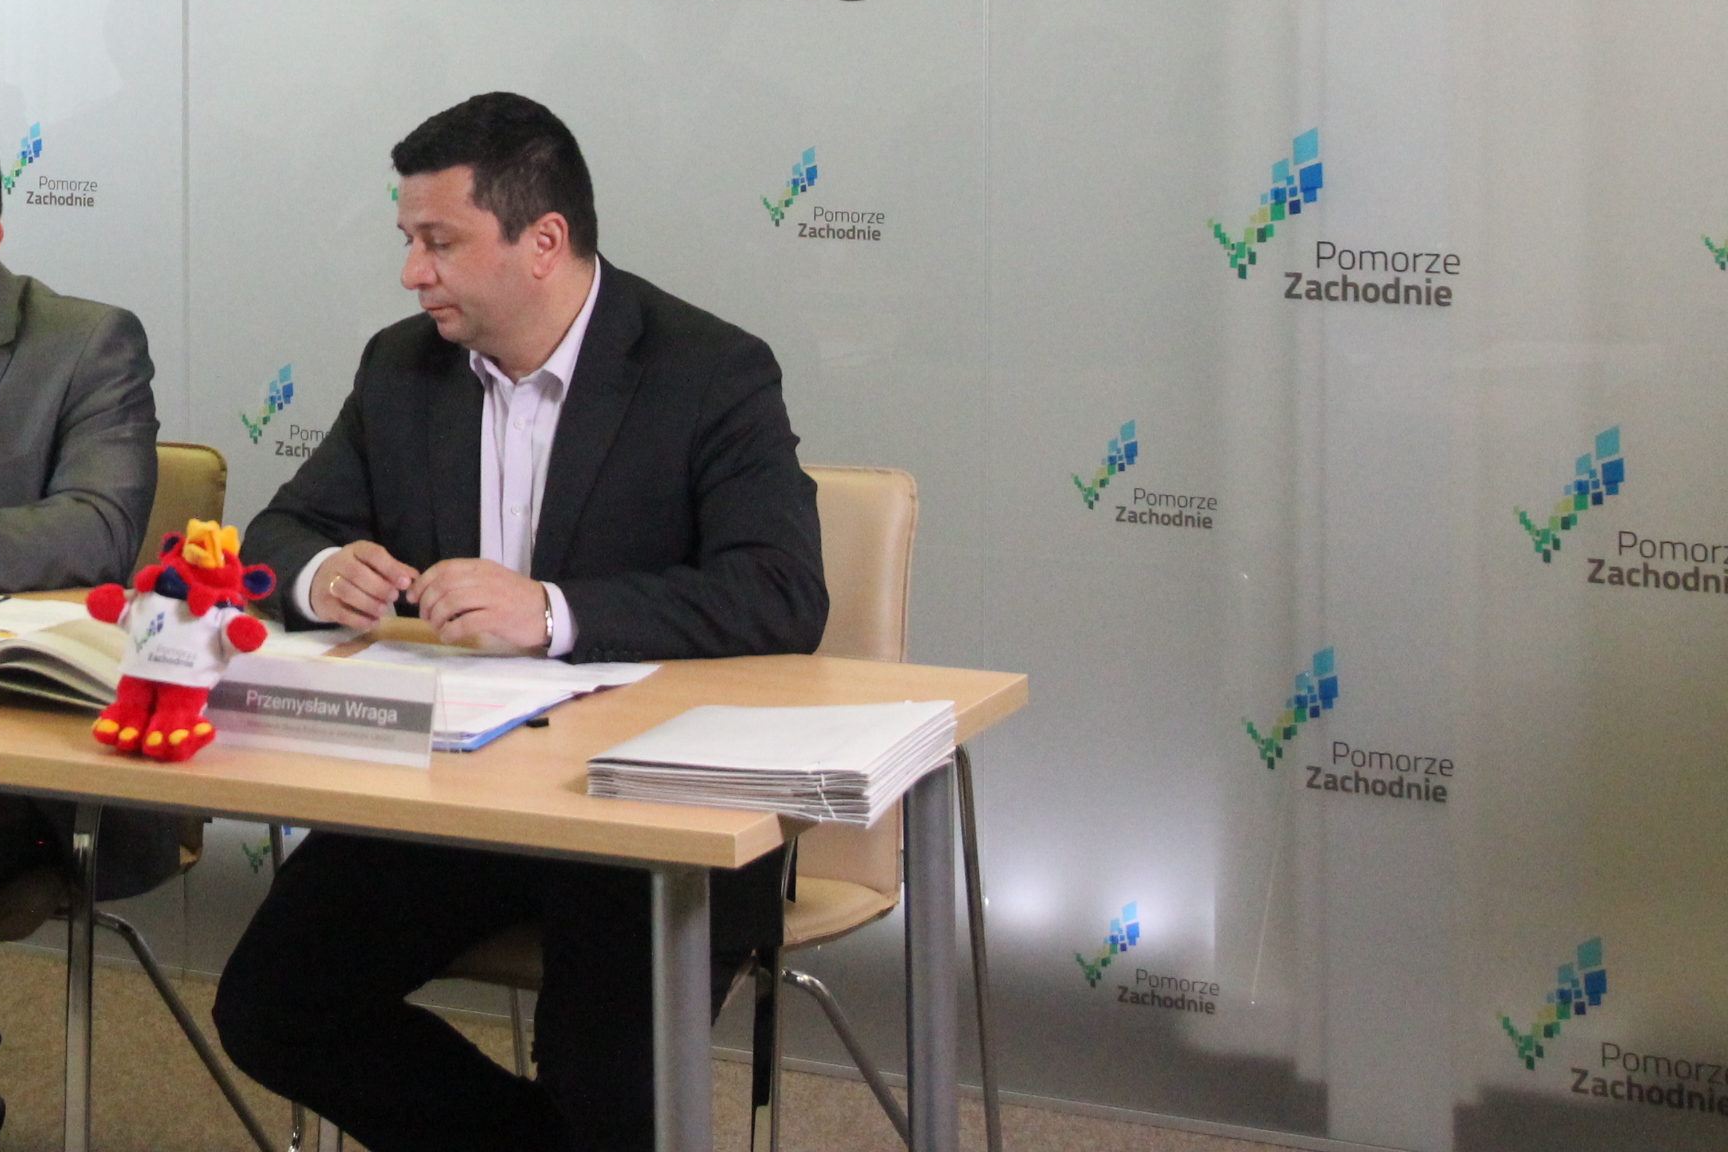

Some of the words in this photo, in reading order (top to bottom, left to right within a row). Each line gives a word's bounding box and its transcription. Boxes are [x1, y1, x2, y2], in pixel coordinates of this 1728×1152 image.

[26, 191, 95, 208] Zachodnie
[38, 175, 98, 192] Pomorze
[797, 223, 882, 242] Zachodnie
[812, 206, 886, 227] Pomorze
[1316, 241, 1462, 278] Pomorze
[1284, 271, 1453, 308] Zachodnie
[1132, 486, 1219, 512] Pomorze
[1114, 504, 1214, 531] Zachodnie
[1618, 530, 1728, 565] Pomor
[1587, 558, 1728, 594] Zachodni
[246, 690, 340, 716] Przemysław
[345, 701, 398, 725] Wraga
[1331, 741, 1455, 778] Pomorze
[1305, 766, 1448, 805] Zachodnie
[1134, 968, 1221, 998] Pomorze
[1116, 986, 1217, 1016] Zachodnie
[1601, 1041, 1728, 1085] Pomorz
